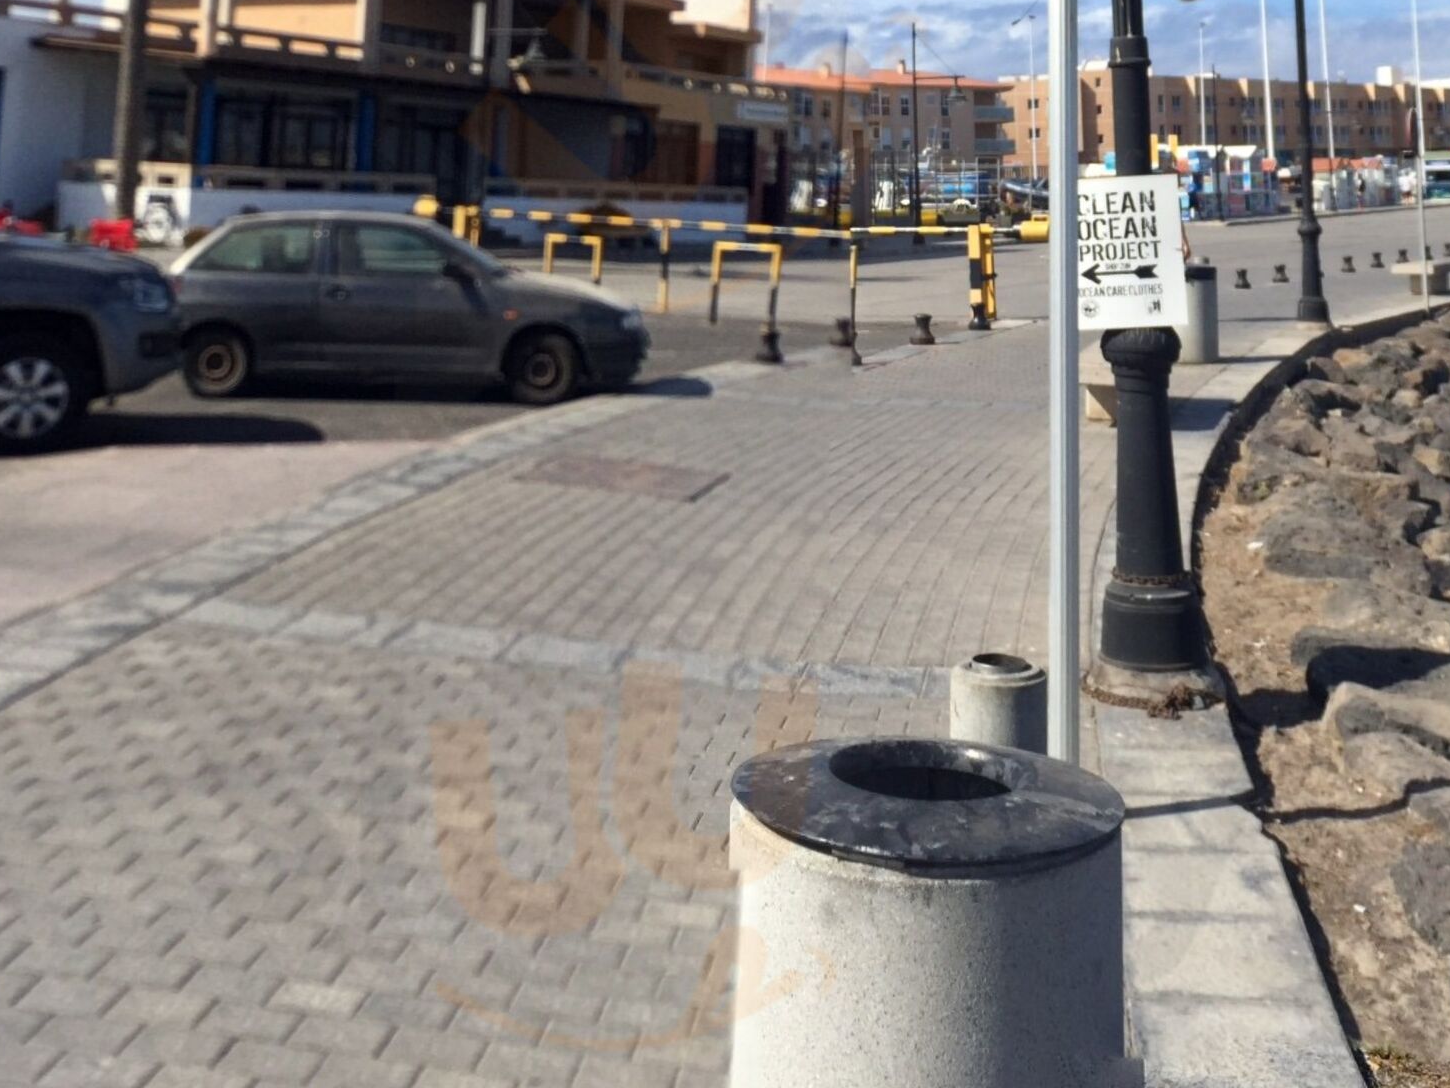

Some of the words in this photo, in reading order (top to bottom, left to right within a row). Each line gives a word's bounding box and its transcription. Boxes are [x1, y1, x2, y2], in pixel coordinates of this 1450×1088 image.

[1078, 189, 1156, 216] CLEAN
[1078, 215, 1158, 242] OCEAN
[1079, 240, 1162, 262] PROJECT
[1106, 285, 1128, 297] CARE
[1128, 283, 1163, 296] CLOTHES
